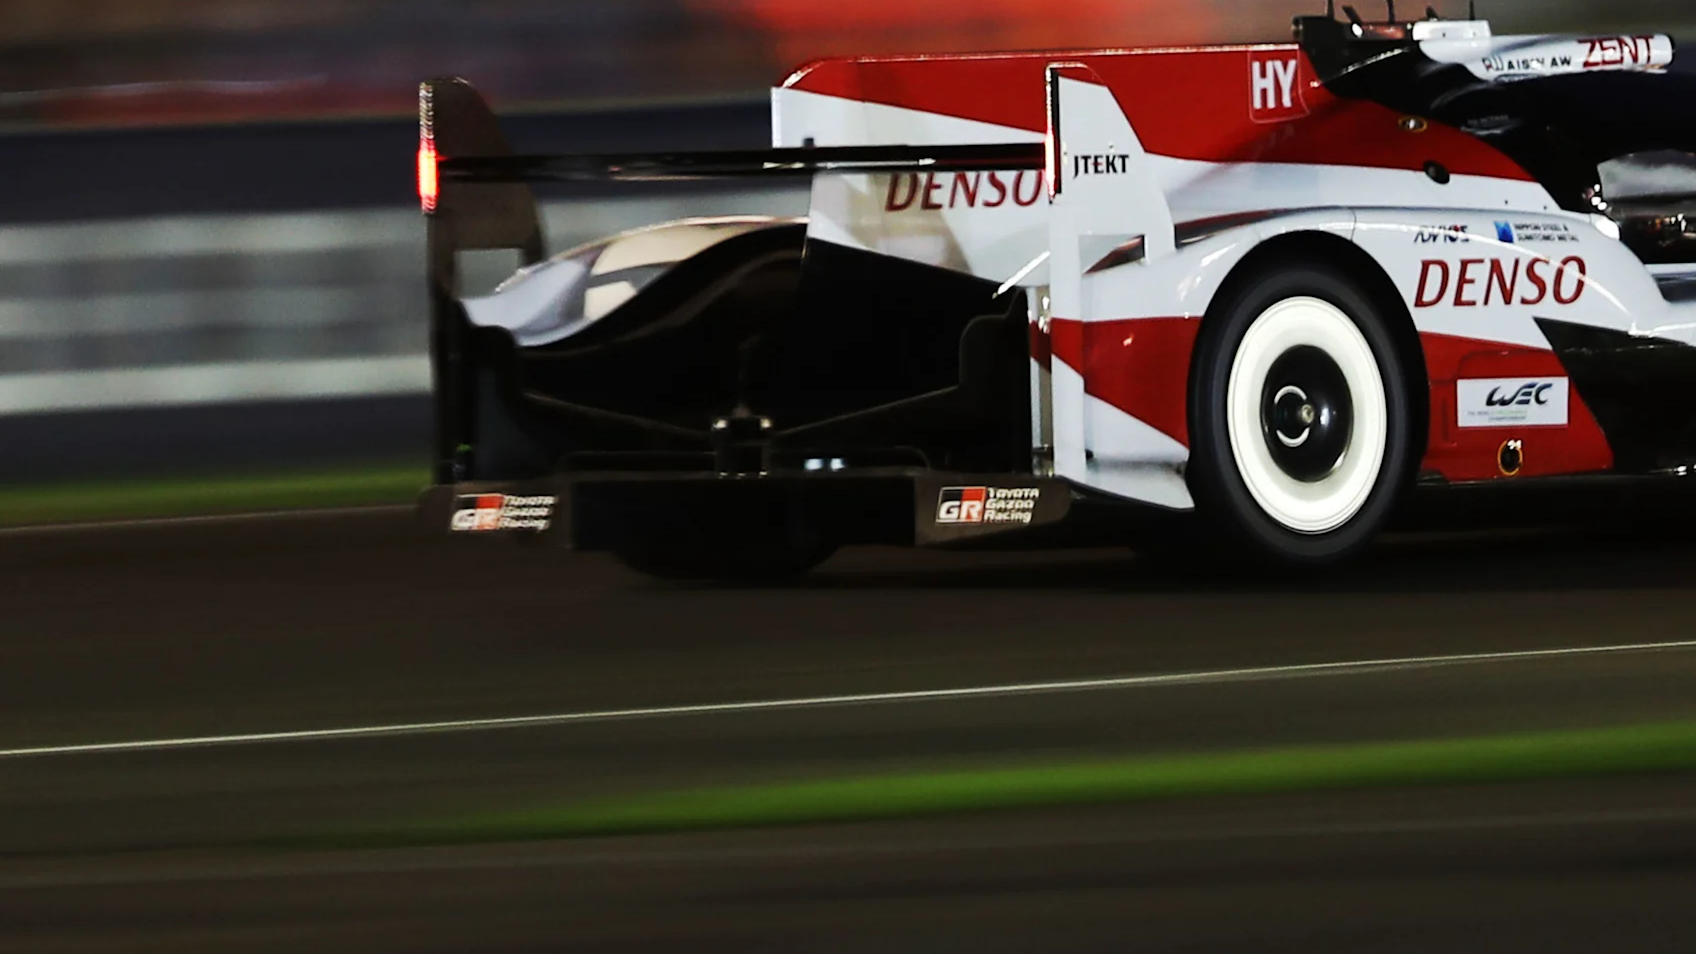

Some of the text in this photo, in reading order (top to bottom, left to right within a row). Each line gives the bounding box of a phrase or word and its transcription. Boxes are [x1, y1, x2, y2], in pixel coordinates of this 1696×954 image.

[1550, 56, 1572, 68] AW
[1577, 34, 1655, 69] ZENT
[1252, 59, 1297, 110] HY
[1073, 154, 1130, 179] JTEKT
[885, 171, 1043, 212] DENSO
[1414, 255, 1587, 308] DENSO
[1485, 382, 1553, 407] WEC
[987, 487, 1040, 499] TOYOTA
[938, 500, 981, 520] GR
[983, 509, 1032, 523] Racing
